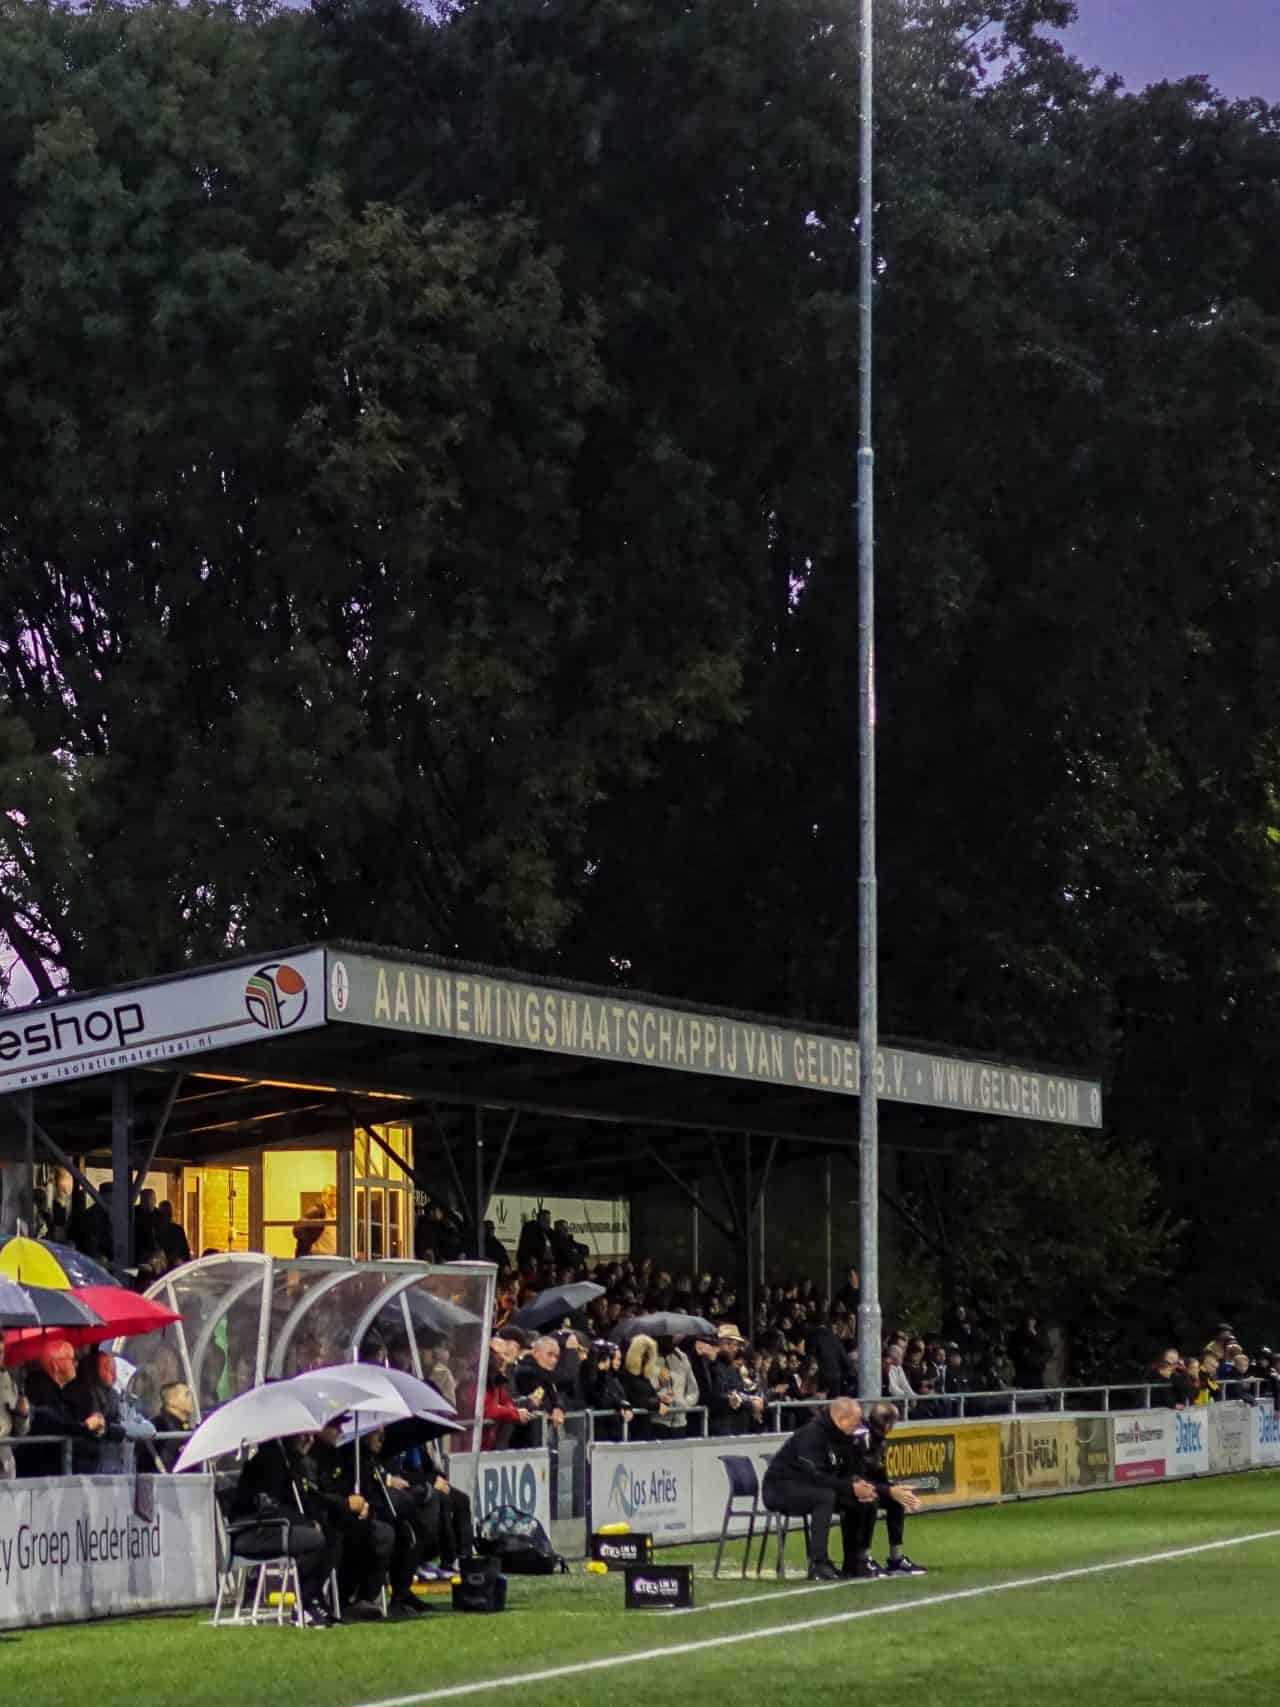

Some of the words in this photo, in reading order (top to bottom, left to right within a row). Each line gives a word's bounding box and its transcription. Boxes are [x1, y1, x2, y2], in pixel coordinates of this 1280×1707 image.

[373, 967, 737, 1072] AANNEMINGSMAATSCHAPPIJ
[743, 1028, 784, 1079] VAN
[793, 1036, 861, 1089] GELDE
[873, 1052, 907, 1097] B.V.
[930, 1059, 1080, 1121] WWW.GELDER.COM
[18, 1524, 71, 1577] Groep
[75, 1515, 162, 1563] Nederland
